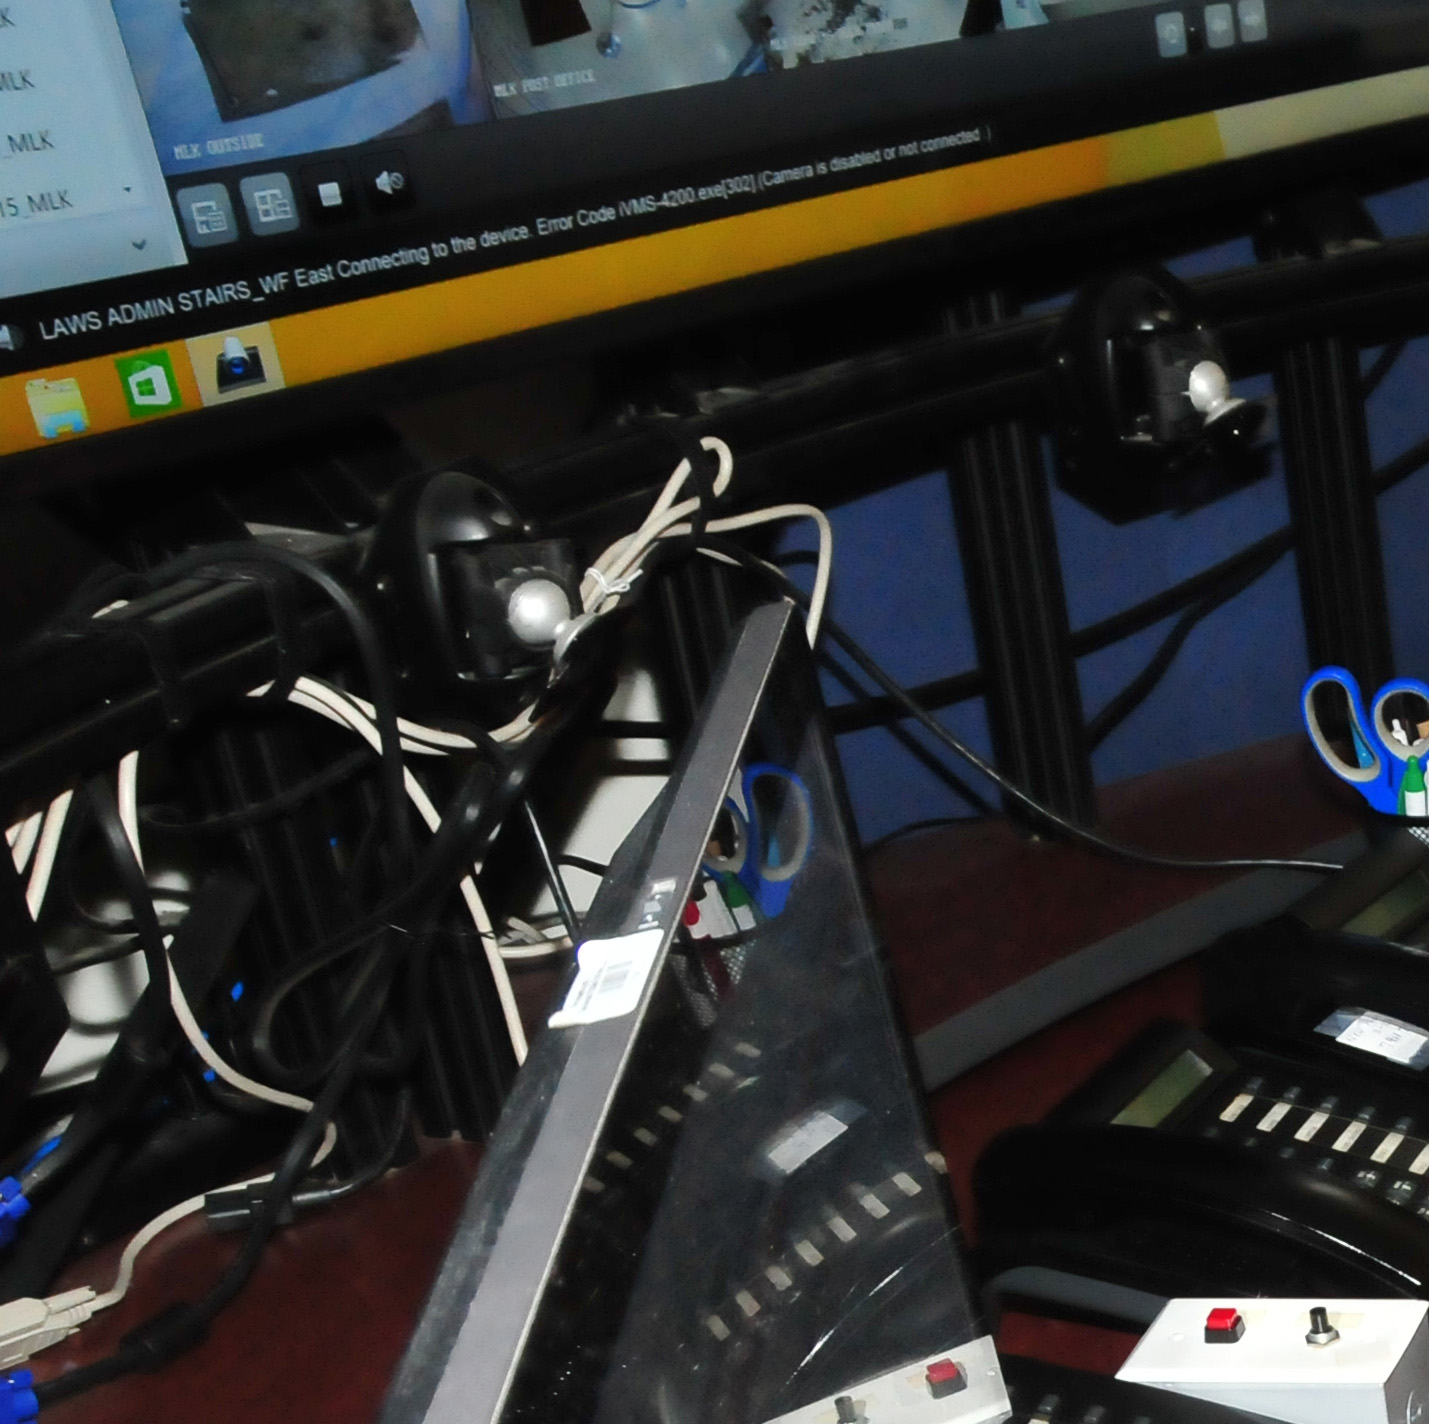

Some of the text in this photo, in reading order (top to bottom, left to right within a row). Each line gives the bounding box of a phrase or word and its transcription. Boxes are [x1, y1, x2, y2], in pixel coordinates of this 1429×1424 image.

[39, 311, 102, 341] LAWS
[107, 297, 174, 327] ADMIN
[177, 271, 289, 312] STAIRS_WF
[295, 263, 334, 288] East
[337, 244, 430, 279] Connecting
[432, 242, 449, 258] to
[450, 233, 477, 254] the
[536, 215, 574, 236] Error
[576, 205, 616, 226] Code
[829, 148, 882, 174] disabled
[898, 139, 919, 158] not
